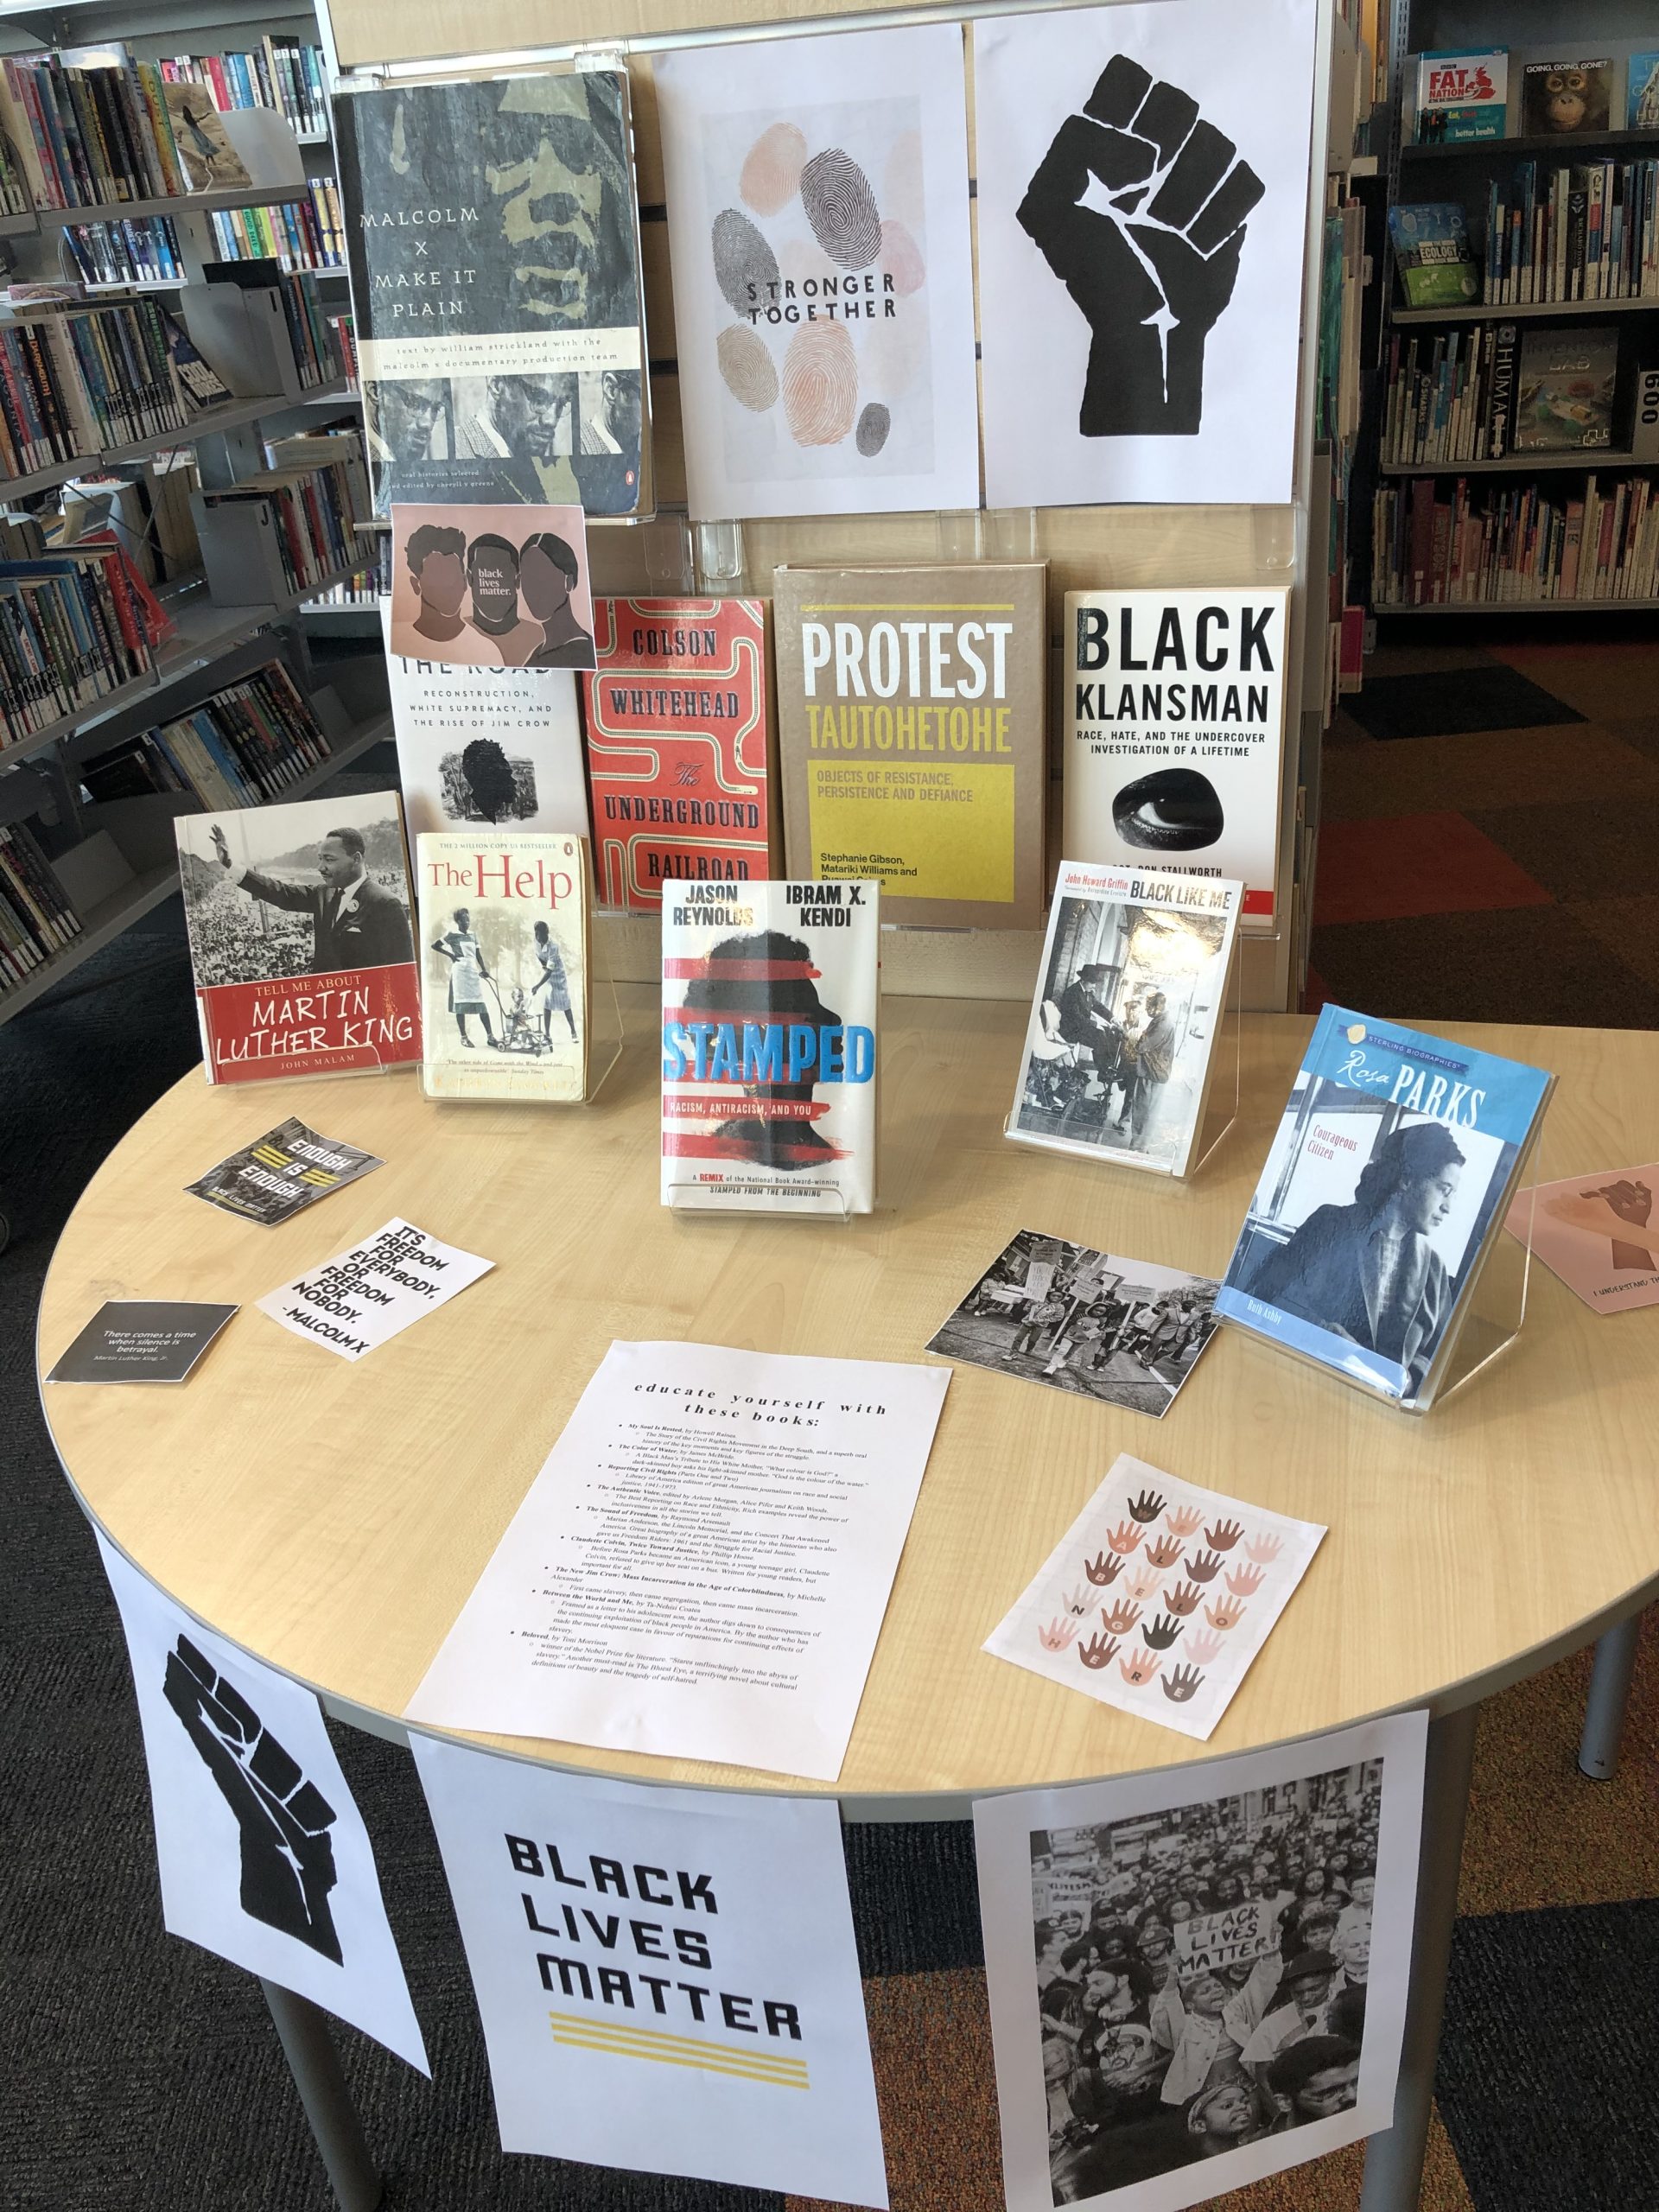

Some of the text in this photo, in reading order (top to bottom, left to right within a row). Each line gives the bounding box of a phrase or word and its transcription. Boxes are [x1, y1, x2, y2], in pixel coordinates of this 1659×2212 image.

[1580, 60, 1608, 70] GONE?
[1429, 69, 1468, 90] FAT
[1429, 88, 1465, 98] NATION
[359, 207, 479, 228] MALCOLM
[415, 241, 428, 256] X
[1420, 245, 1458, 258] ECOLOGY
[375, 270, 476, 289] MAKE IT
[747, 273, 895, 302] STRONGER
[393, 301, 463, 318] PLAIN
[748, 298, 896, 325] TOGETHER
[424, 345, 435, 354] by
[441, 342, 483, 353] william
[489, 340, 548, 351] strickland
[553, 339, 577, 348] with
[583, 338, 601, 346] the
[29, 340, 52, 397] DARKMOUTH
[383, 360, 429, 371] malcolm
[445, 356, 517, 368] documentary
[523, 354, 585, 365] production
[591, 352, 619, 360] team
[479, 568, 504, 578] black
[479, 578, 500, 588] lives
[480, 587, 512, 596] matter.
[632, 629, 717, 657] COLSON
[1077, 606, 1275, 672] BLACK
[801, 621, 1014, 699] PROTEST
[449, 705, 522, 714] SUPREMACY,
[610, 689, 740, 719] WHITEHEAD
[1076, 683, 1269, 723] KLANSMAN
[414, 719, 550, 728] THE RISE OF JIM CROW
[805, 705, 1013, 753] TAUTOHETOHE
[1077, 731, 1265, 743] RACE, HATE, AND THE UNDERCOVER
[1090, 743, 1249, 757] INVESTIGATION OF A LIFETIME
[670, 761, 704, 787] The
[817, 770, 954, 786] OBJECTS OF RESISTANCE,
[817, 786, 973, 802] PERSISTENCE AND DEFIANCE
[604, 795, 759, 829] UNDERGROUND
[647, 853, 749, 880] RAILROAD
[821, 853, 905, 866] Stephanie Gibson,
[821, 864, 918, 876] Matariki Williams and
[427, 855, 573, 910] The Help
[1065, 873, 1080, 884] John
[1083, 875, 1106, 887] Howard
[1107, 878, 1128, 890] Griffin
[1130, 880, 1174, 903] BLACK
[1176, 886, 1207, 906] LIKE
[1209, 890, 1232, 910] ME
[685, 886, 738, 904] JASON
[785, 886, 866, 906] IBRAM X.
[673, 906, 753, 926] REYNOLDS
[800, 908, 851, 927] KENDI
[255, 976, 362, 997] TELL ME ABOUT
[252, 986, 369, 1027] MARTIN
[216, 1014, 413, 1065] LUTHER KING
[1369, 1036, 1404, 1052] STERLING
[280, 1054, 355, 1070] JOHN MALAM
[664, 1022, 874, 1084] STAMPED
[1337, 1050, 1486, 1129] Rosa PARKS
[670, 1102, 811, 1116] RACISM, ANTIRACISM, AND YOU
[1313, 1124, 1358, 1152] Courageous
[287, 1139, 353, 1170] ENOUGH
[1307, 1140, 1334, 1160] Citizen
[283, 1162, 308, 1176] IS
[699, 1173, 724, 1183] REMIX
[792, 1178, 840, 1186] Award-winning
[239, 1166, 304, 1198] ENOUGH
[394, 1226, 426, 1246] IT'S
[369, 1244, 404, 1266] FOR
[375, 1232, 450, 1271] FREEDOM
[343, 1262, 370, 1280] OR
[348, 1250, 441, 1300] EVERYBODY,
[313, 1278, 349, 1300] FOR
[321, 1266, 396, 1306] FREEDOM
[1599, 1280, 1648, 1295] UNDERSTAND
[291, 1281, 363, 1324] NOBODY.
[286, 1307, 370, 1354] MALCOLM X
[634, 1383, 887, 1415] educate yourself with
[684, 1403, 819, 1427] these books:
[641, 1575, 686, 1586] Incarceration
[505, 1833, 719, 1915] BLACK
[521, 1892, 713, 1970] LIVES
[1187, 1906, 1261, 1935] BLACK
[1191, 1923, 1257, 1951] LIVES
[1176, 1929, 1277, 1974] MATTER!
[536, 1952, 803, 2041] MATTER
